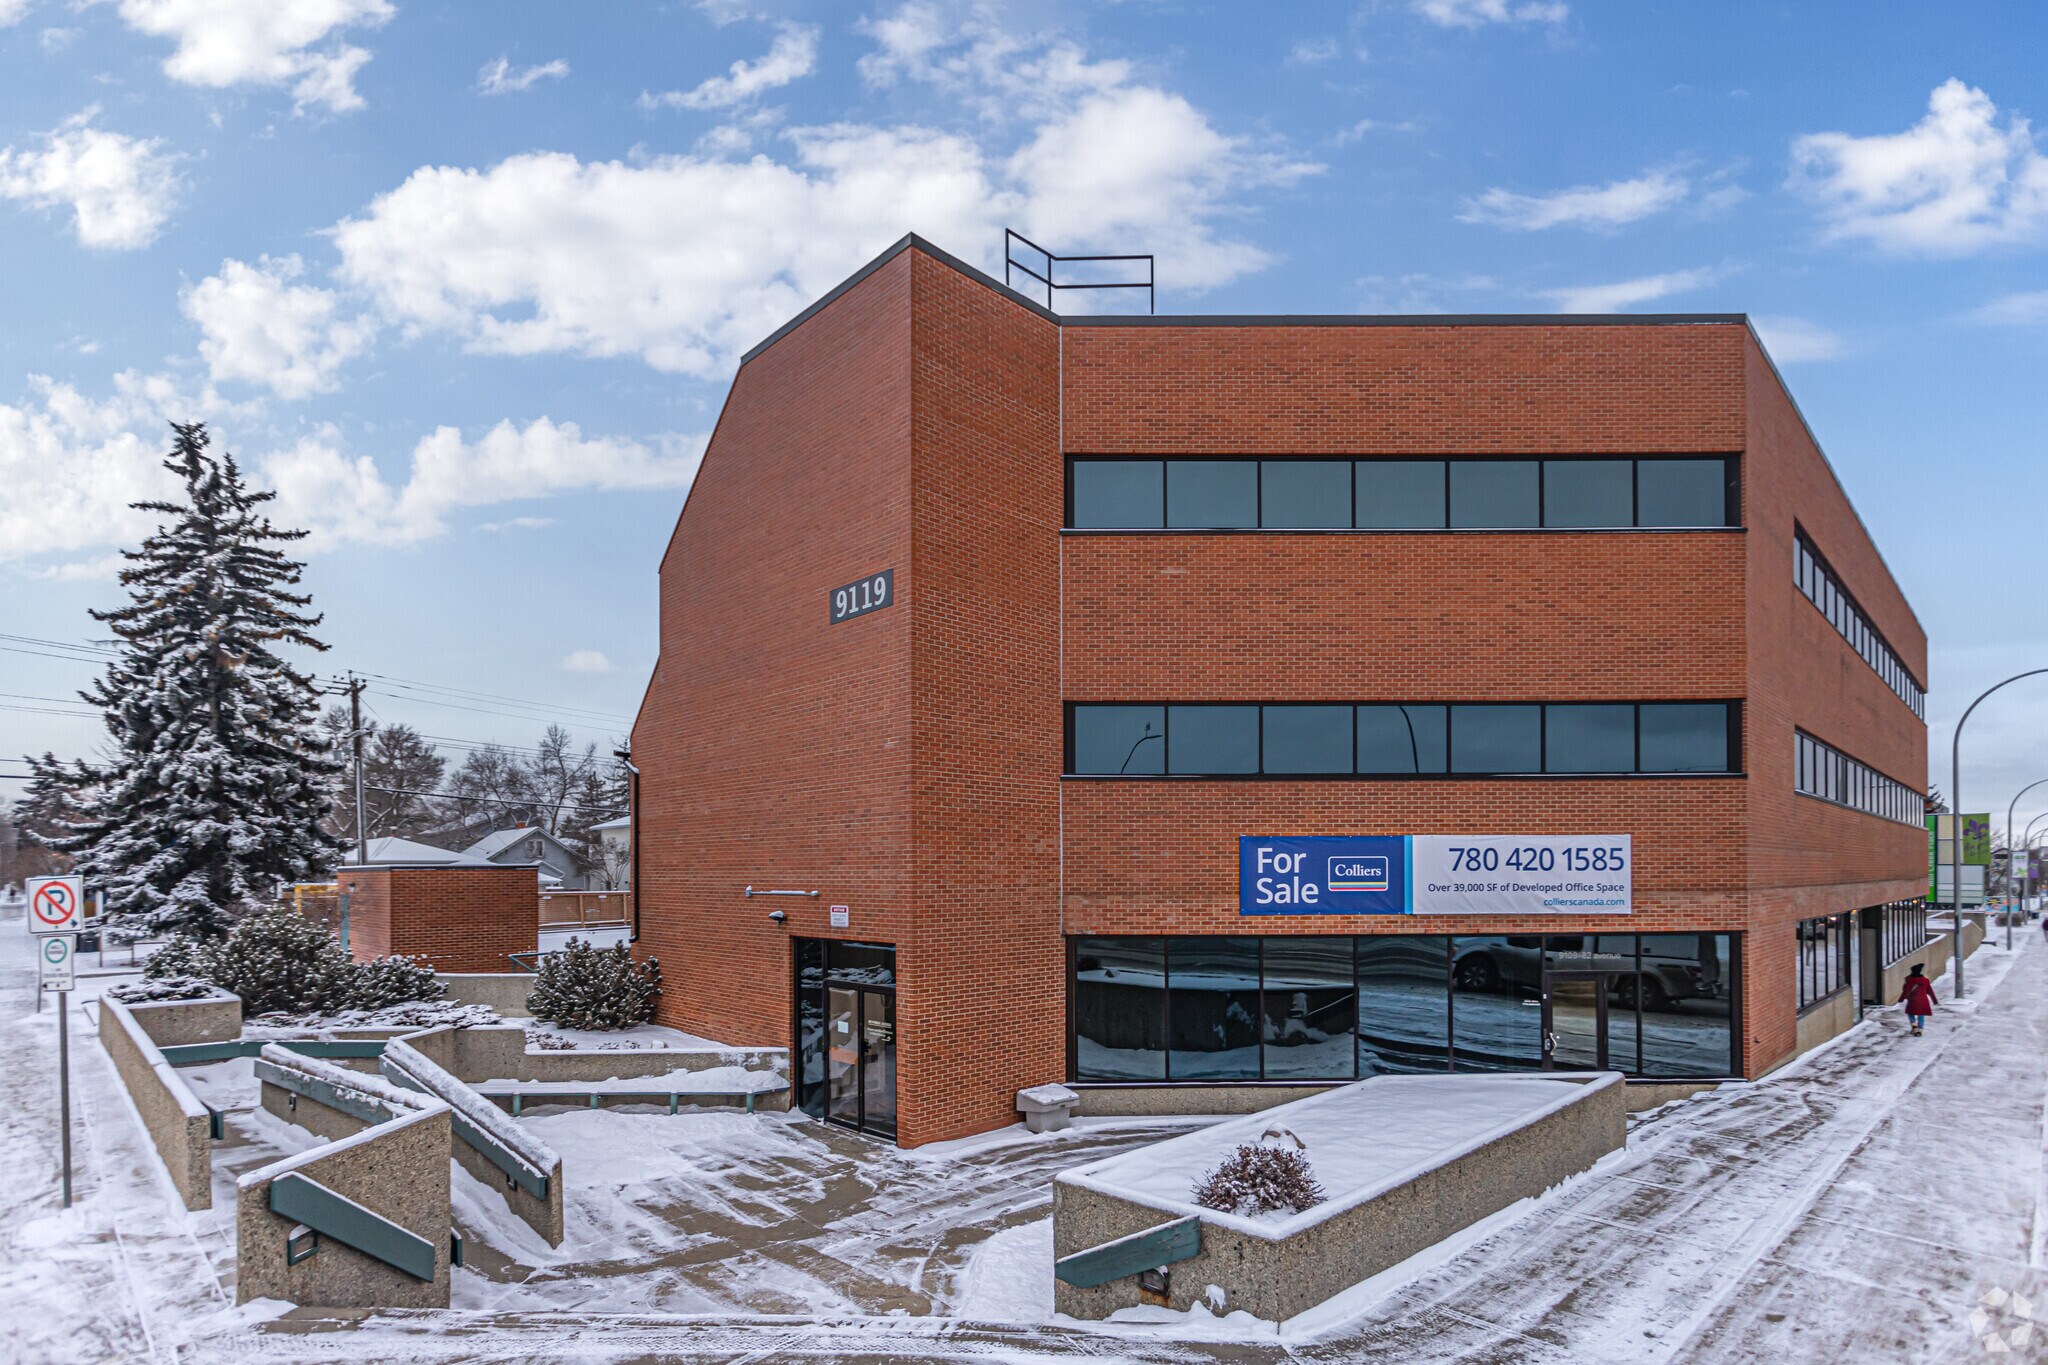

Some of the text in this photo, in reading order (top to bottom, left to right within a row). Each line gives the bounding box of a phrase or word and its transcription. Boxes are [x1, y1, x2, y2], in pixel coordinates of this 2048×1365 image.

[836, 576, 886, 618] 9119
[1257, 847, 1307, 874] For
[1334, 863, 1382, 877] Colliers
[1448, 847, 1625, 872] 780 420 1585
[1256, 876, 1319, 904] Sale
[1428, 883, 1625, 894] Over 39,000 SF of Developed Office Space
[1543, 897, 1625, 906] collierscanada.com
